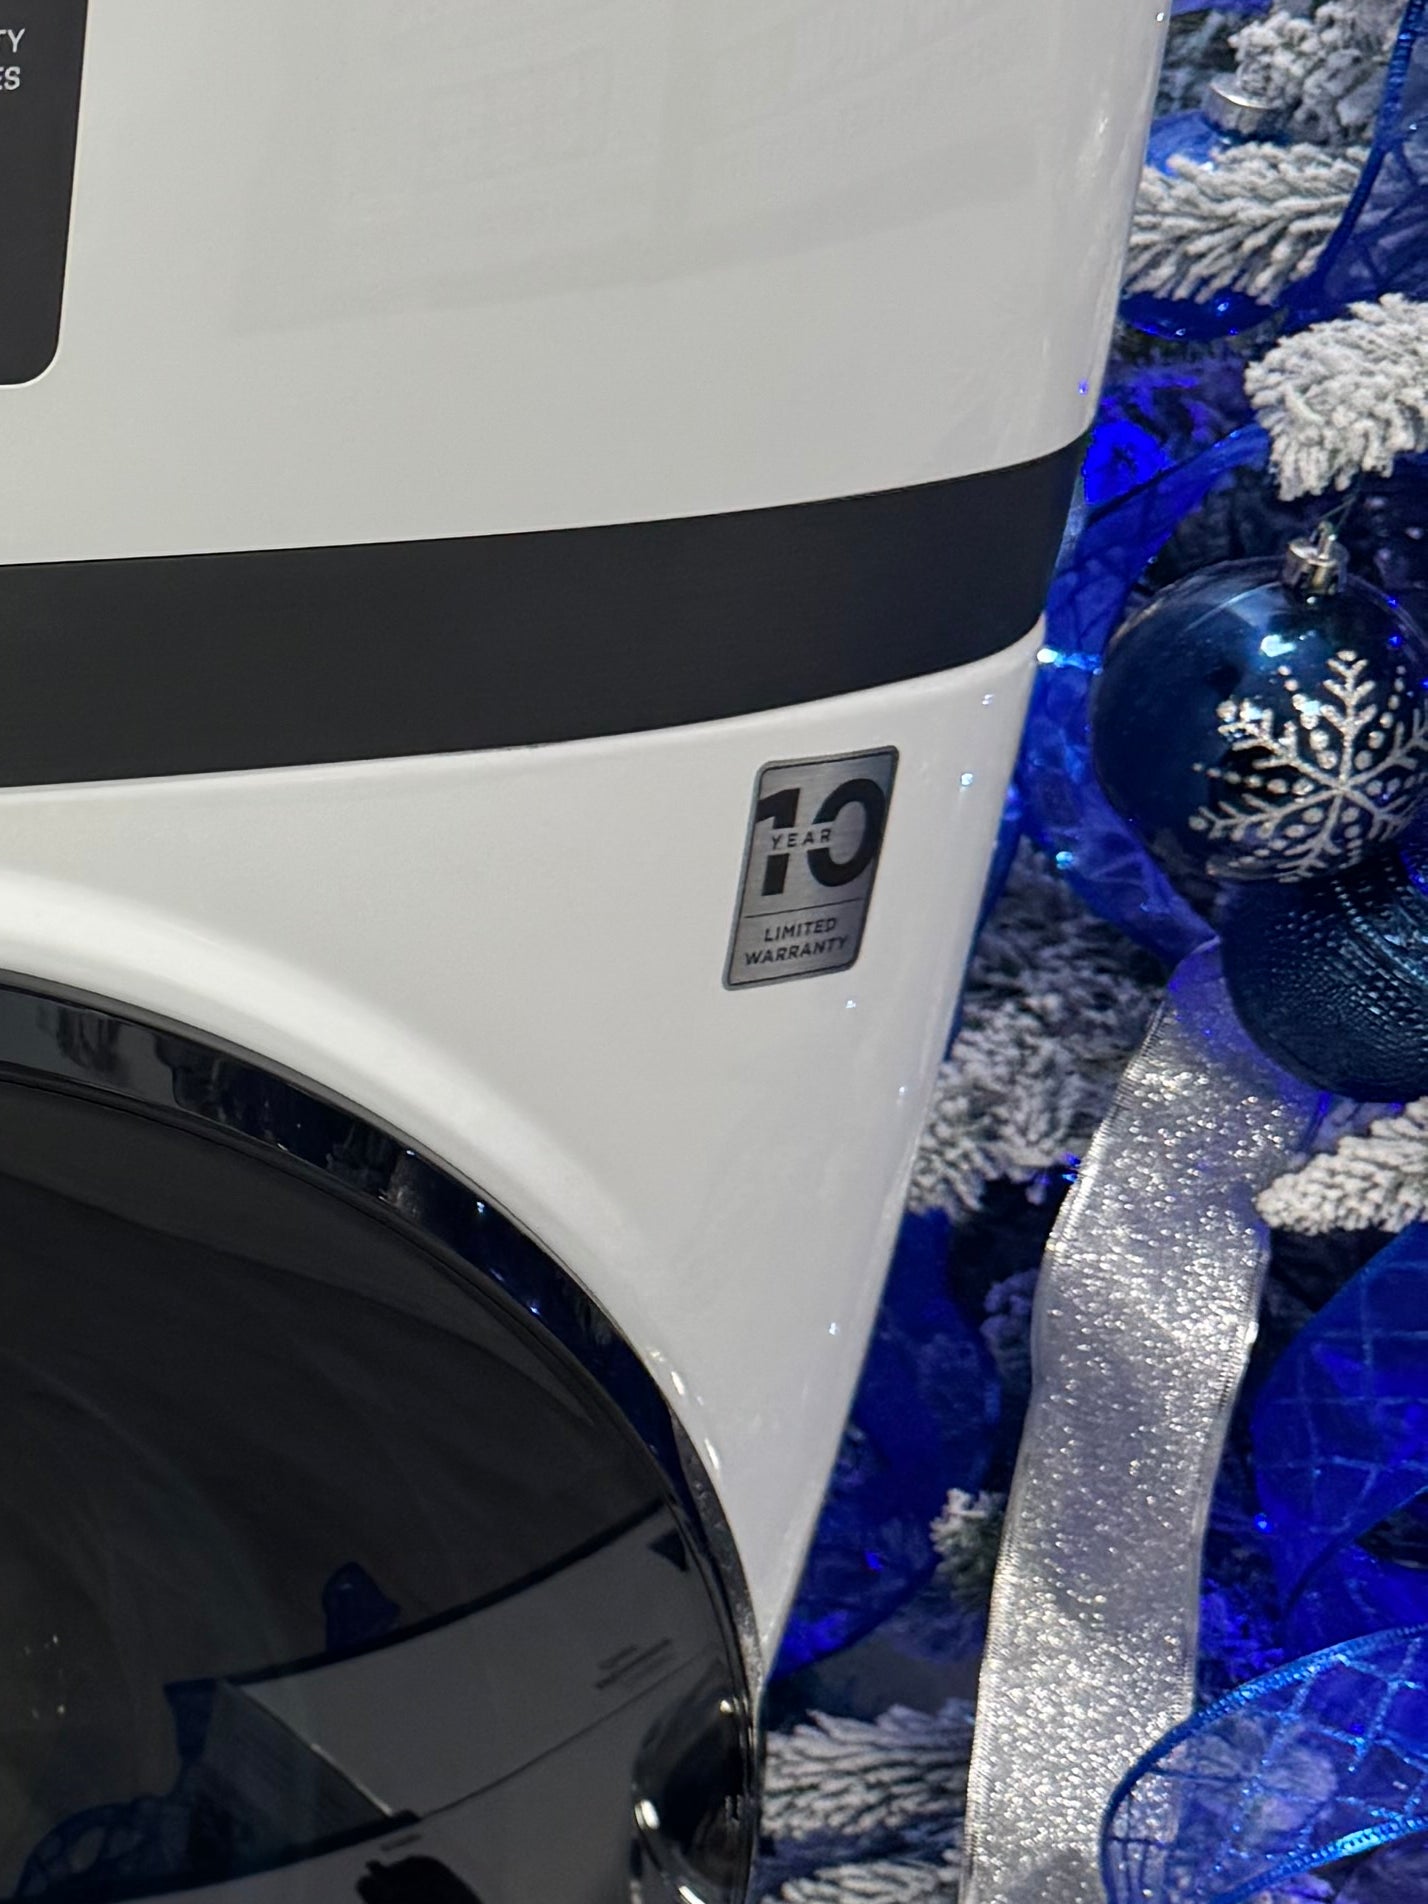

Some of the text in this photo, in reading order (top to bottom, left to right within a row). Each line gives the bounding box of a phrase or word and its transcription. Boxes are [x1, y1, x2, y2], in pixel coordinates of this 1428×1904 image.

[754, 777, 887, 897] 10
[770, 827, 833, 851] YEAR
[763, 916, 839, 943] LIMITED
[745, 935, 850, 966] WARRANTY
